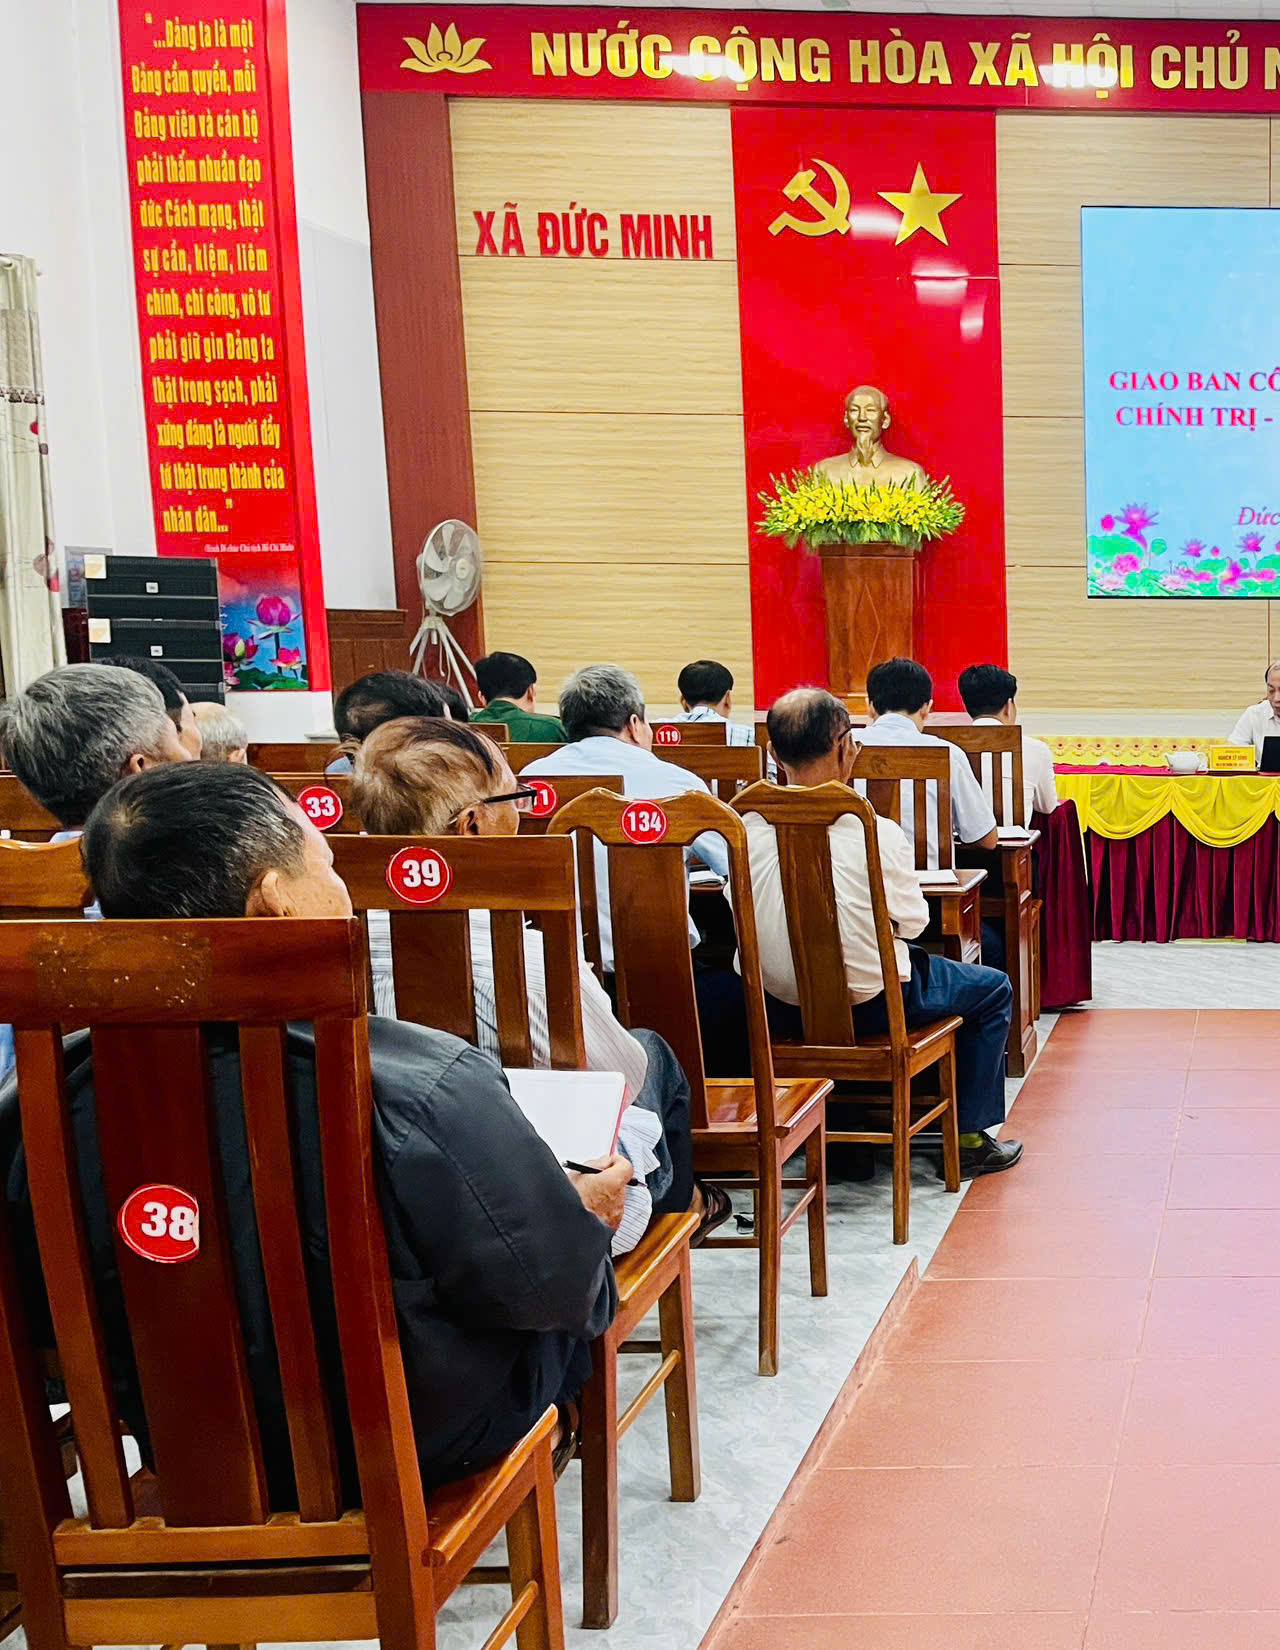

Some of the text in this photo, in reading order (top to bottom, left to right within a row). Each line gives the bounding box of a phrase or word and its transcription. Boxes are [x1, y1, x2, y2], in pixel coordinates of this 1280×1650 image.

[199, 21, 211, 48] ta
[214, 19, 227, 47] là
[230, 19, 253, 53] một
[530, 20, 673, 78] NƯỚC
[688, 27, 831, 92] CỘNG
[849, 28, 952, 85] HÒA
[968, 32, 1039, 88] XÃ
[1051, 33, 1133, 98] HỘI
[1150, 29, 1248, 90] CHỦ
[135, 107, 258, 143] Đảng viên và cán bộ
[137, 152, 164, 186] phải
[239, 154, 261, 188] đạo
[473, 202, 713, 259] XÃ ĐỨC MINH
[144, 247, 159, 277] sự
[194, 243, 233, 277] kiệm,
[237, 243, 267, 271] liêm
[147, 288, 270, 319] chính, chí công, vô tư
[150, 330, 177, 363] phải
[181, 332, 200, 362] giữ
[226, 330, 258, 363] Đảng
[261, 334, 274, 360] ta
[153, 372, 277, 408] thật trong sạch, phải
[1110, 372, 1179, 391] GIAO
[1188, 372, 1240, 391] BAN
[1116, 402, 1204, 426] CHÍNH
[1211, 408, 1256, 432] TRỊ
[160, 462, 172, 489] tớ
[174, 462, 196, 495] thật
[198, 464, 228, 492] trung
[264, 459, 284, 489] của
[164, 506, 193, 532] nhân
[1237, 507, 1280, 525] Đức
[659, 731, 679, 743] 119
[306, 796, 334, 818] 33
[627, 811, 662, 832] 134
[402, 859, 441, 888] 39
[141, 1201, 195, 1242] 38
